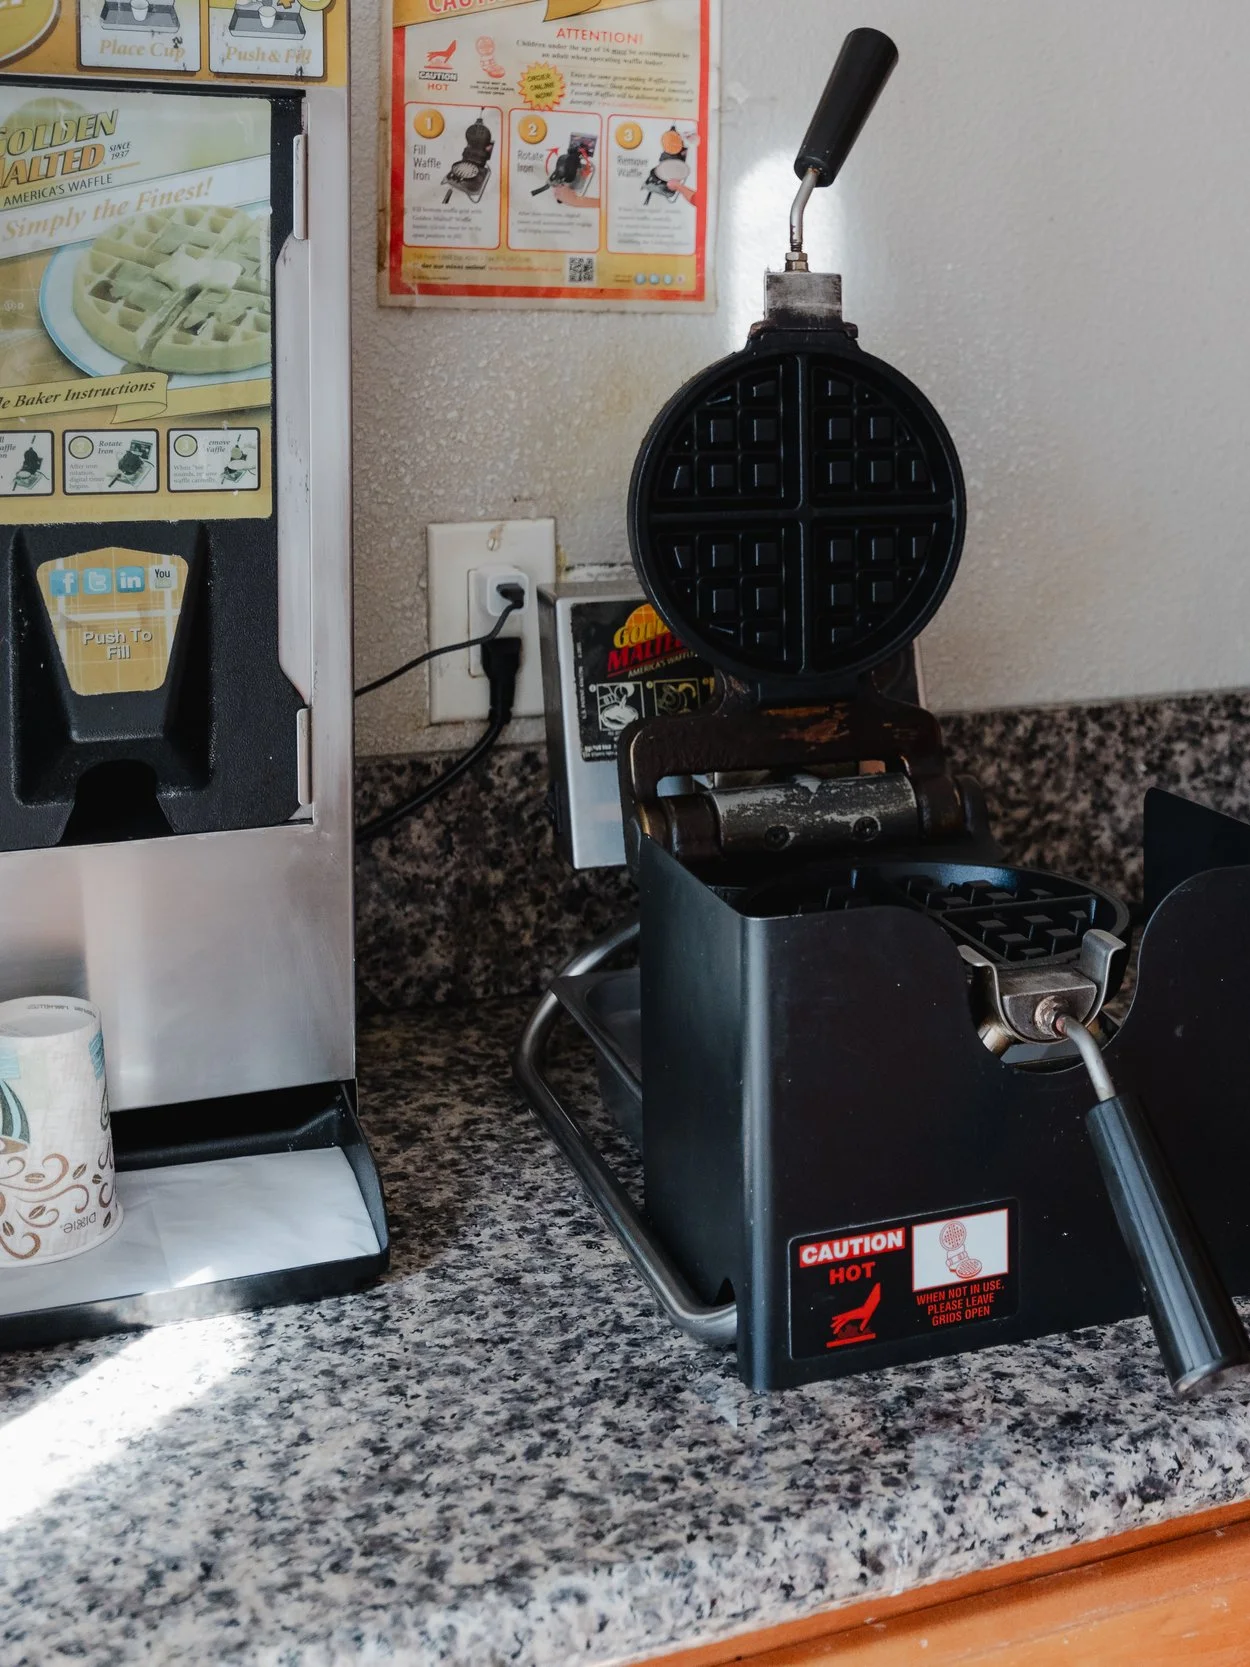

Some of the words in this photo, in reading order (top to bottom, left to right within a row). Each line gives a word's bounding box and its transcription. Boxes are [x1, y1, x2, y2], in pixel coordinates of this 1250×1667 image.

[556, 28, 643, 44] ATTENTION!
[100, 39, 144, 57] Place
[150, 42, 186, 61] Cup
[226, 45, 266, 62] Push
[267, 51, 281, 62] &
[284, 48, 312, 65] Fill
[420, 72, 458, 82] CAUTION
[528, 73, 551, 82] ORDER
[427, 83, 449, 91] HOT
[426, 117, 432, 130] 1
[528, 122, 538, 136] 2
[624, 128, 634, 142] 3
[108, 142, 131, 153] SINCE
[413, 144, 426, 155] Fill
[111, 150, 130, 160] 1937
[517, 150, 544, 160] Rotate
[616, 156, 648, 166] Remove
[0, 143, 105, 188] ALTED
[413, 158, 441, 169] Waffle
[517, 163, 534, 173] Iron
[413, 170, 430, 180] Iron
[3, 184, 65, 208] AMERICA'S
[68, 173, 113, 192] WAFFLE
[3, 206, 86, 241] Simply
[93, 199, 130, 221] the
[136, 177, 214, 212] Finest!
[14, 392, 62, 408] Baker
[64, 380, 156, 402] Instructions
[0, 444, 16, 452] affle
[120, 572, 142, 588] in
[154, 568, 171, 580] You
[82, 630, 126, 646] Push
[130, 628, 152, 644] To
[106, 646, 131, 660] Fill
[628, 660, 666, 678] AMERICA'S
[802, 1228, 903, 1265] CAUTION
[829, 1262, 876, 1286] HOT
[916, 1289, 946, 1306] WHEN
[948, 1286, 968, 1300] NOT
[970, 1284, 980, 1294] IN
[982, 1280, 1005, 1294] USE,
[927, 1298, 964, 1316] PLEASE
[966, 1292, 995, 1308] LEAVE
[932, 1311, 962, 1327] GRIDS
[964, 1306, 991, 1321] OPEN
